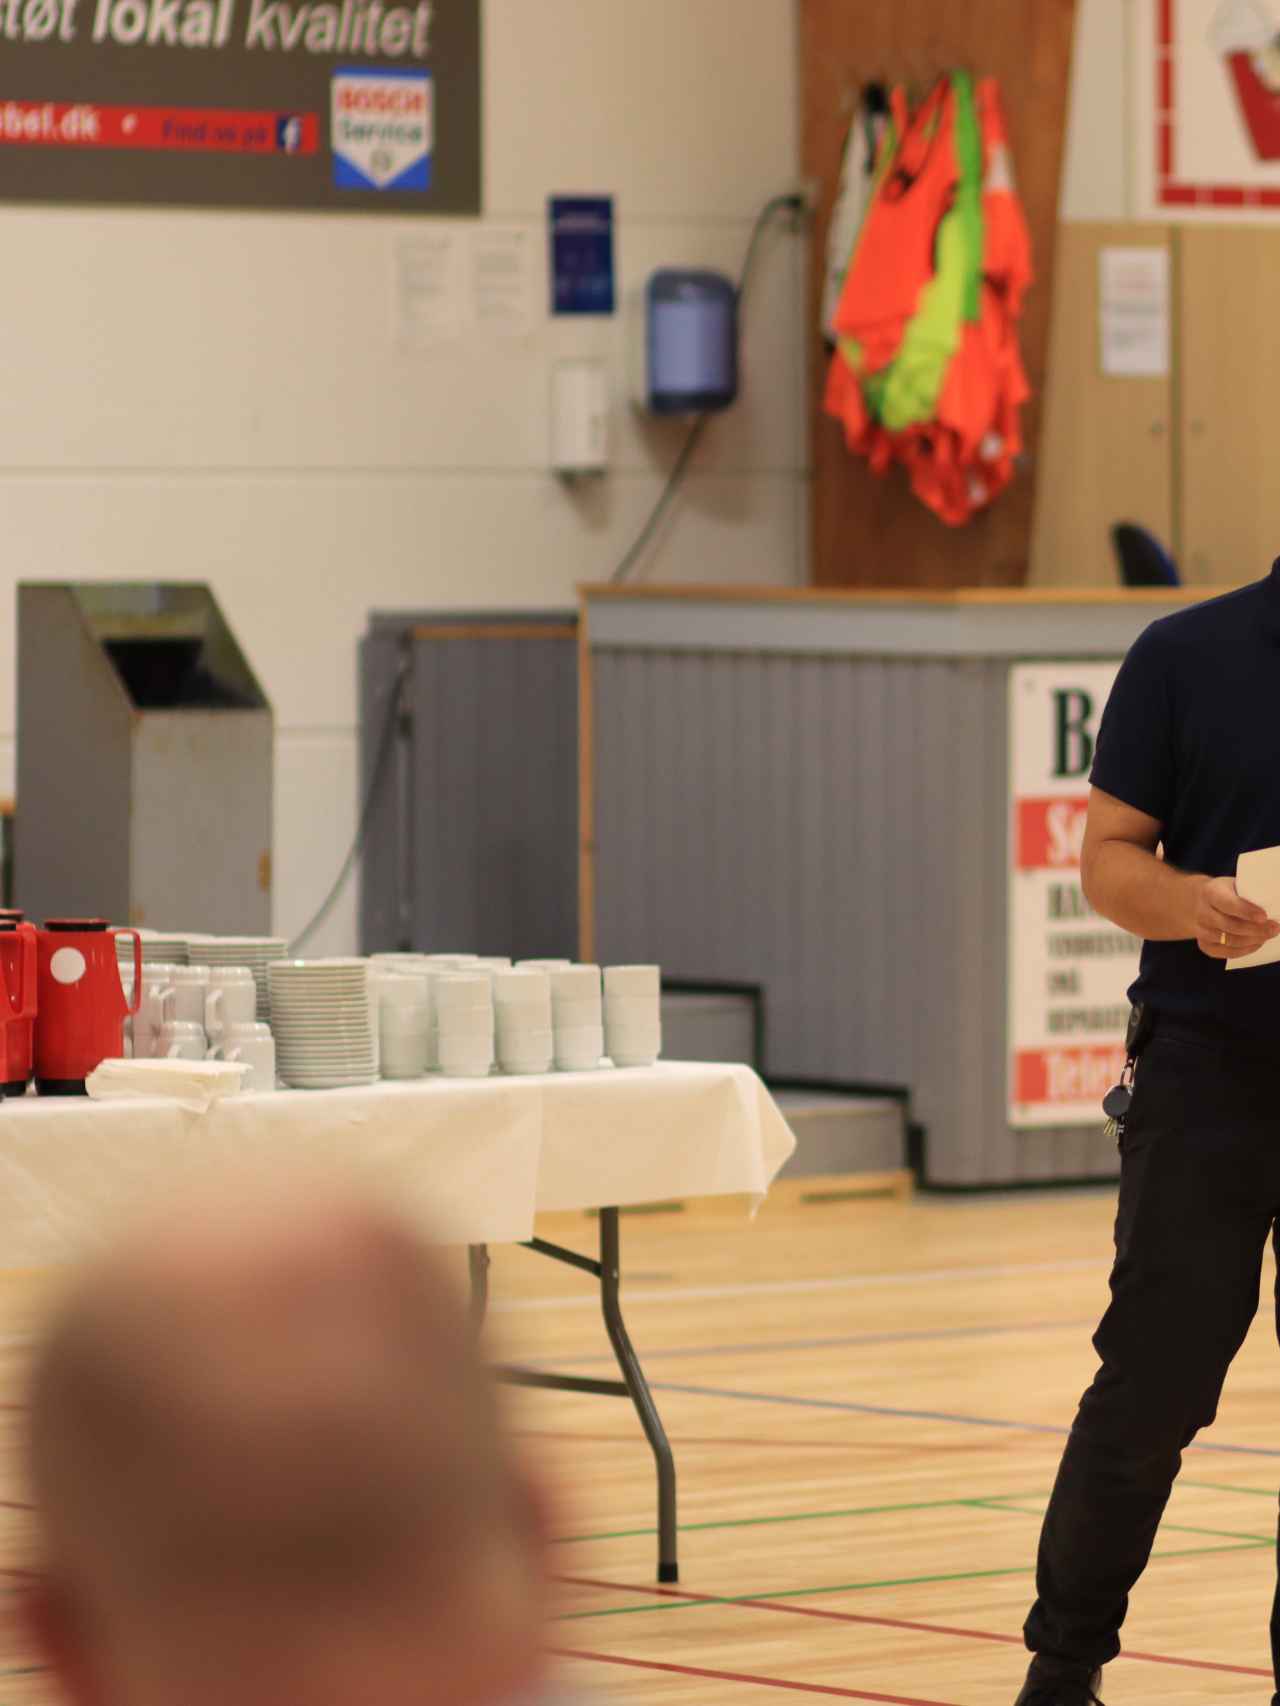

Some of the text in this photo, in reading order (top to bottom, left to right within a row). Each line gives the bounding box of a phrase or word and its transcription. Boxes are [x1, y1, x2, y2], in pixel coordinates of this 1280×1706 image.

[92, 0, 230, 49] lokal
[244, 0, 435, 57] kvalitet
[341, 88, 423, 112] BOSCH
[340, 119, 423, 143] Service
